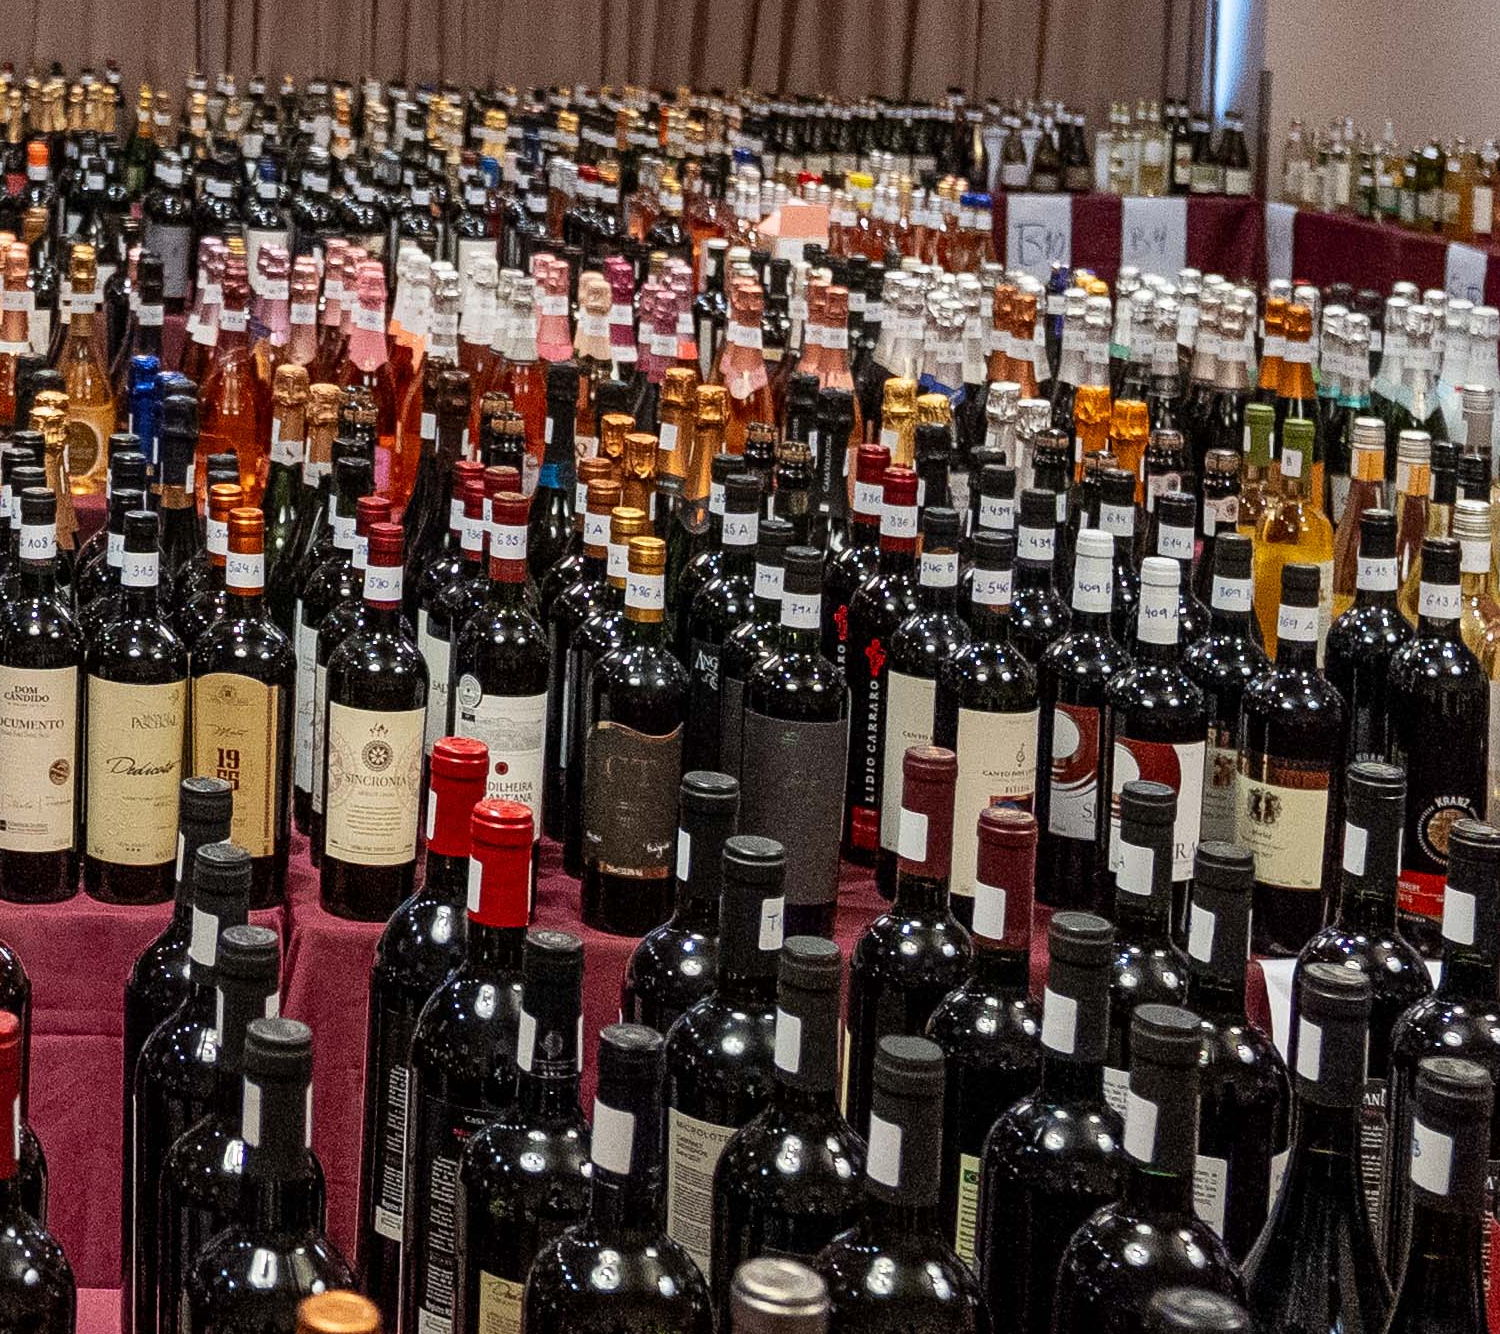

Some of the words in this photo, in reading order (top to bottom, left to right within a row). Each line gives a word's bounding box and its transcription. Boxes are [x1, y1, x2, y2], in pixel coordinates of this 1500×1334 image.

[14, 685, 39, 696] DOM
[866, 678, 879, 755] CARRARO
[217, 747, 241, 769] 19
[488, 780, 534, 793] DILHEIRA
[864, 756, 876, 803] LIDIO
